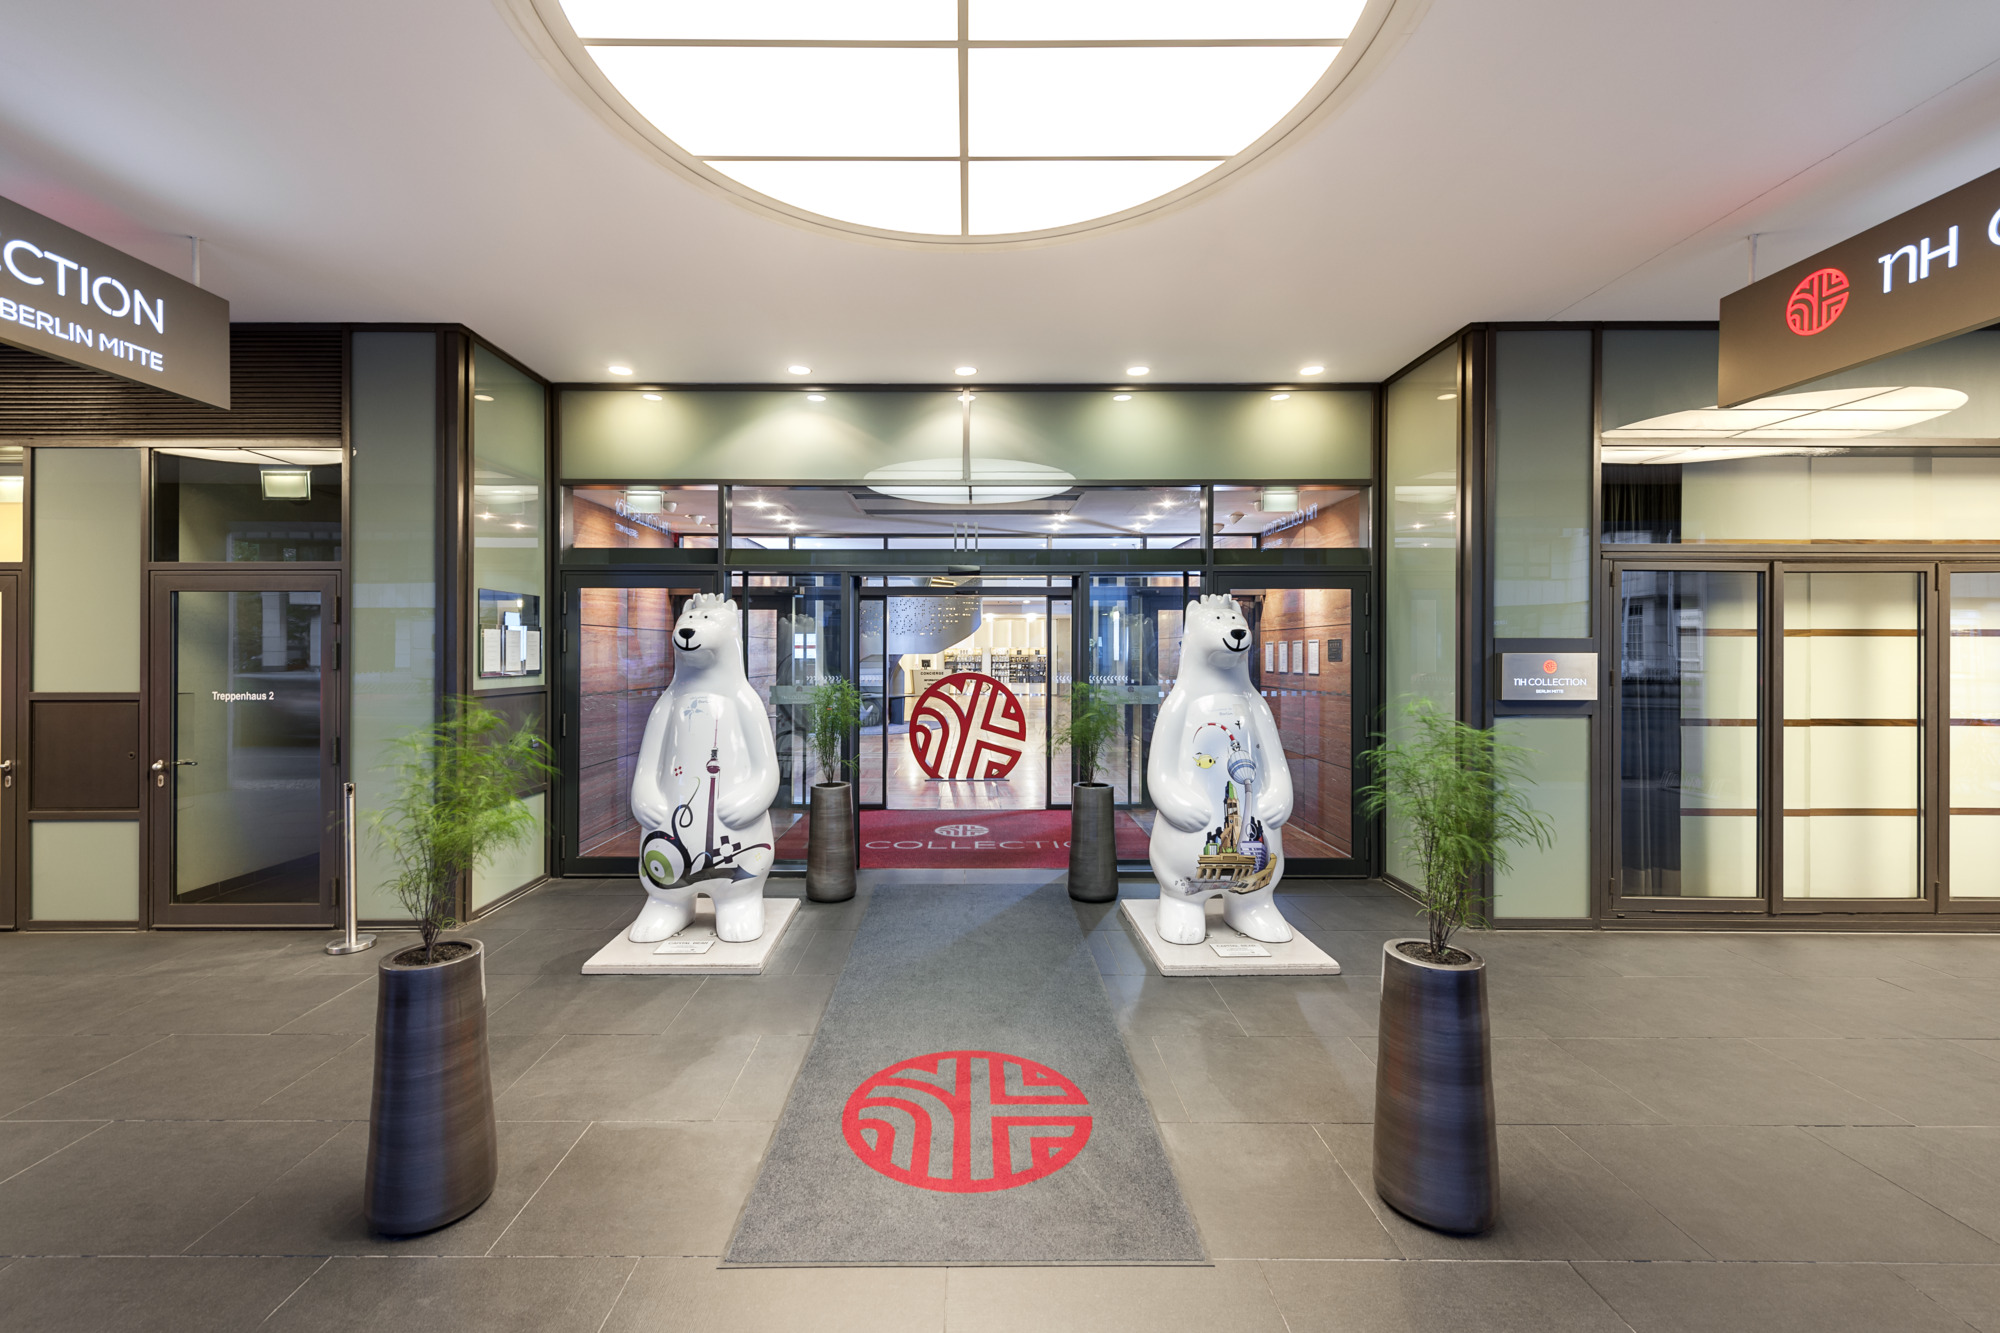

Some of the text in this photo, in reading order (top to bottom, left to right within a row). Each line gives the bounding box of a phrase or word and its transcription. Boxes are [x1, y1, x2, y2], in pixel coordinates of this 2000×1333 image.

[0, 239, 164, 334] CTION
[0, 297, 164, 372] BERLIN MITTE
[1528, 678, 1587, 686] COLLECTION
[212, 691, 275, 703] Treppenhaus 2
[865, 840, 1071, 850] COLLECTI
